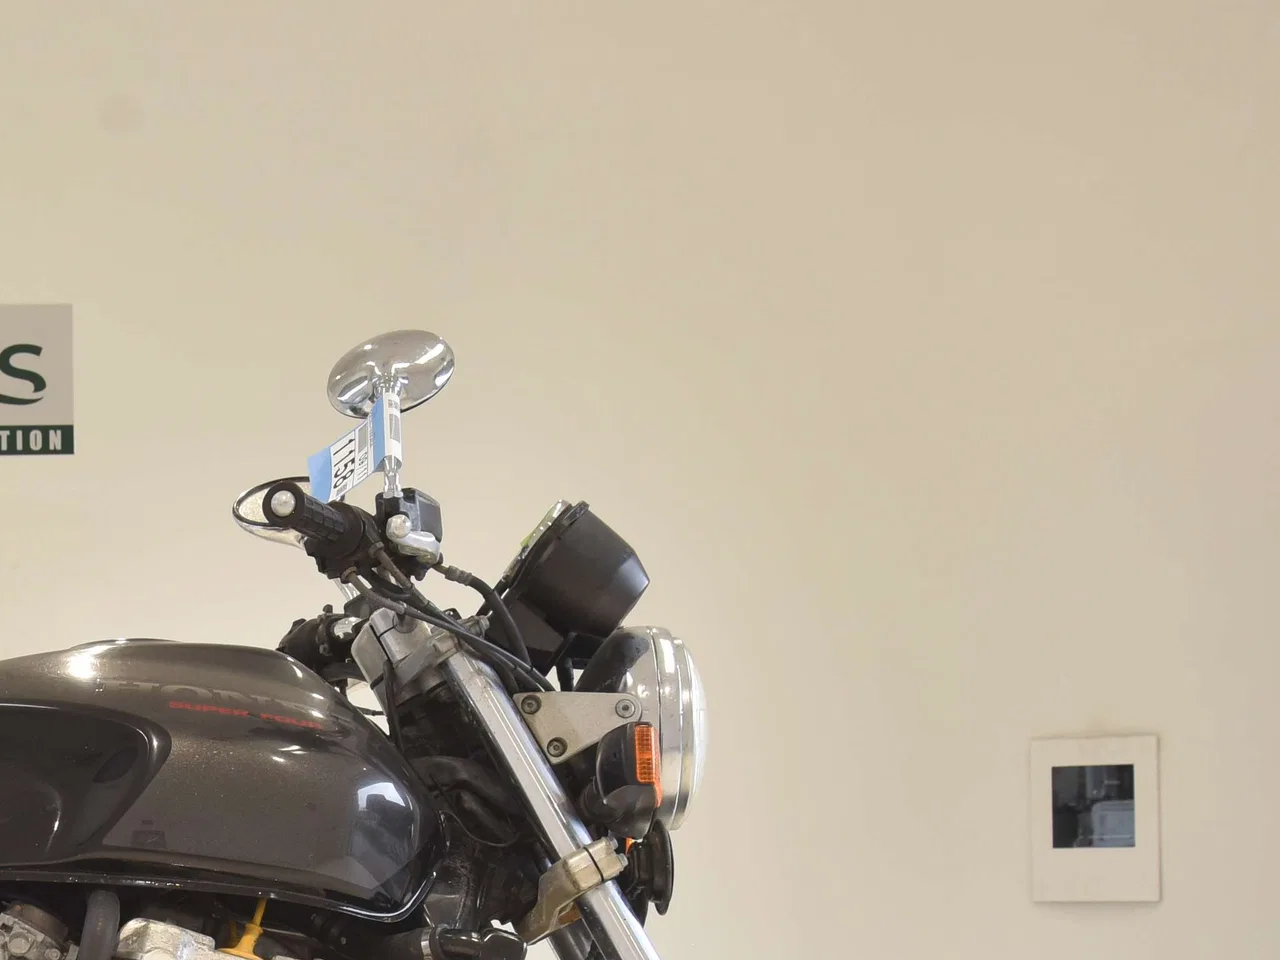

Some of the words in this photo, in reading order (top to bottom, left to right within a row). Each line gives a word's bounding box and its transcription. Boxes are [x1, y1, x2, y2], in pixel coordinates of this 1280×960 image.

[332, 438, 355, 489] 1158
[169, 701, 249, 717] SUPER
[260, 713, 324, 730] FOUR
